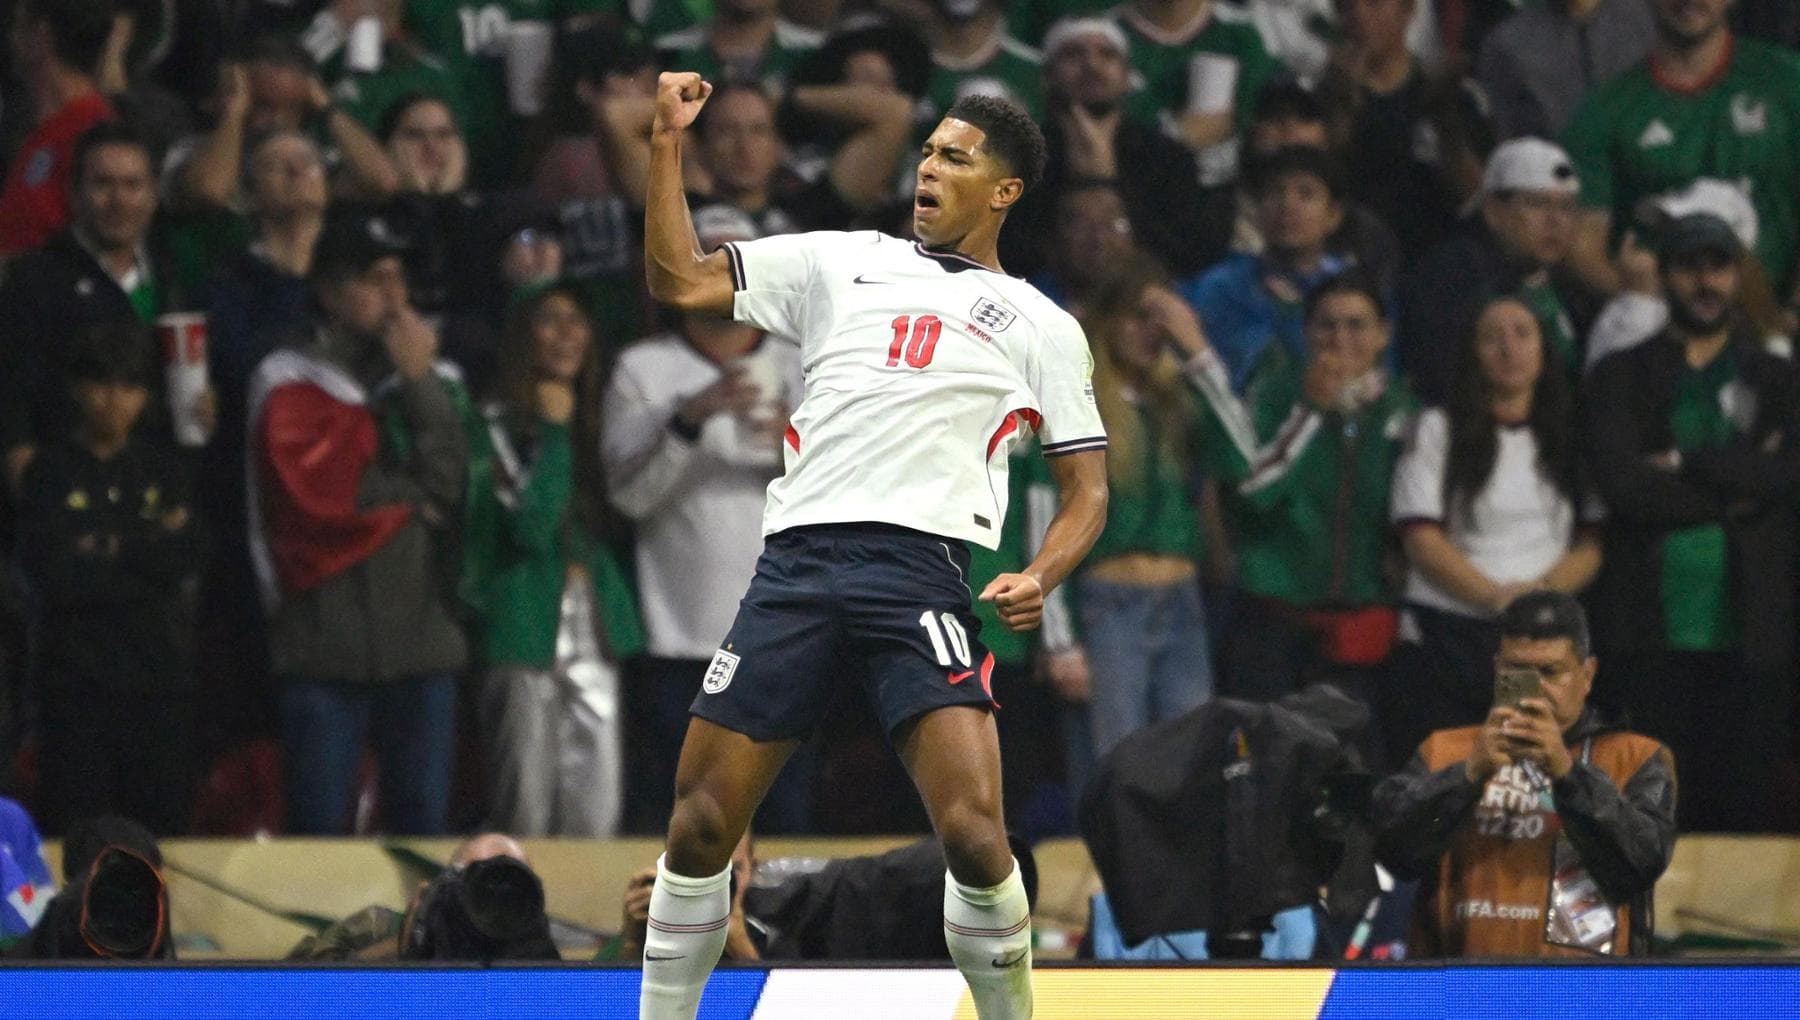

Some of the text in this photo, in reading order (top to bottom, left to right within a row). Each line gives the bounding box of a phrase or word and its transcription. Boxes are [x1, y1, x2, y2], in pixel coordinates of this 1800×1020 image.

[885, 315, 942, 369] 10
[964, 322, 993, 344] MEXICO
[919, 610, 971, 668] 10
[1455, 900, 1540, 920] FIFA.com
